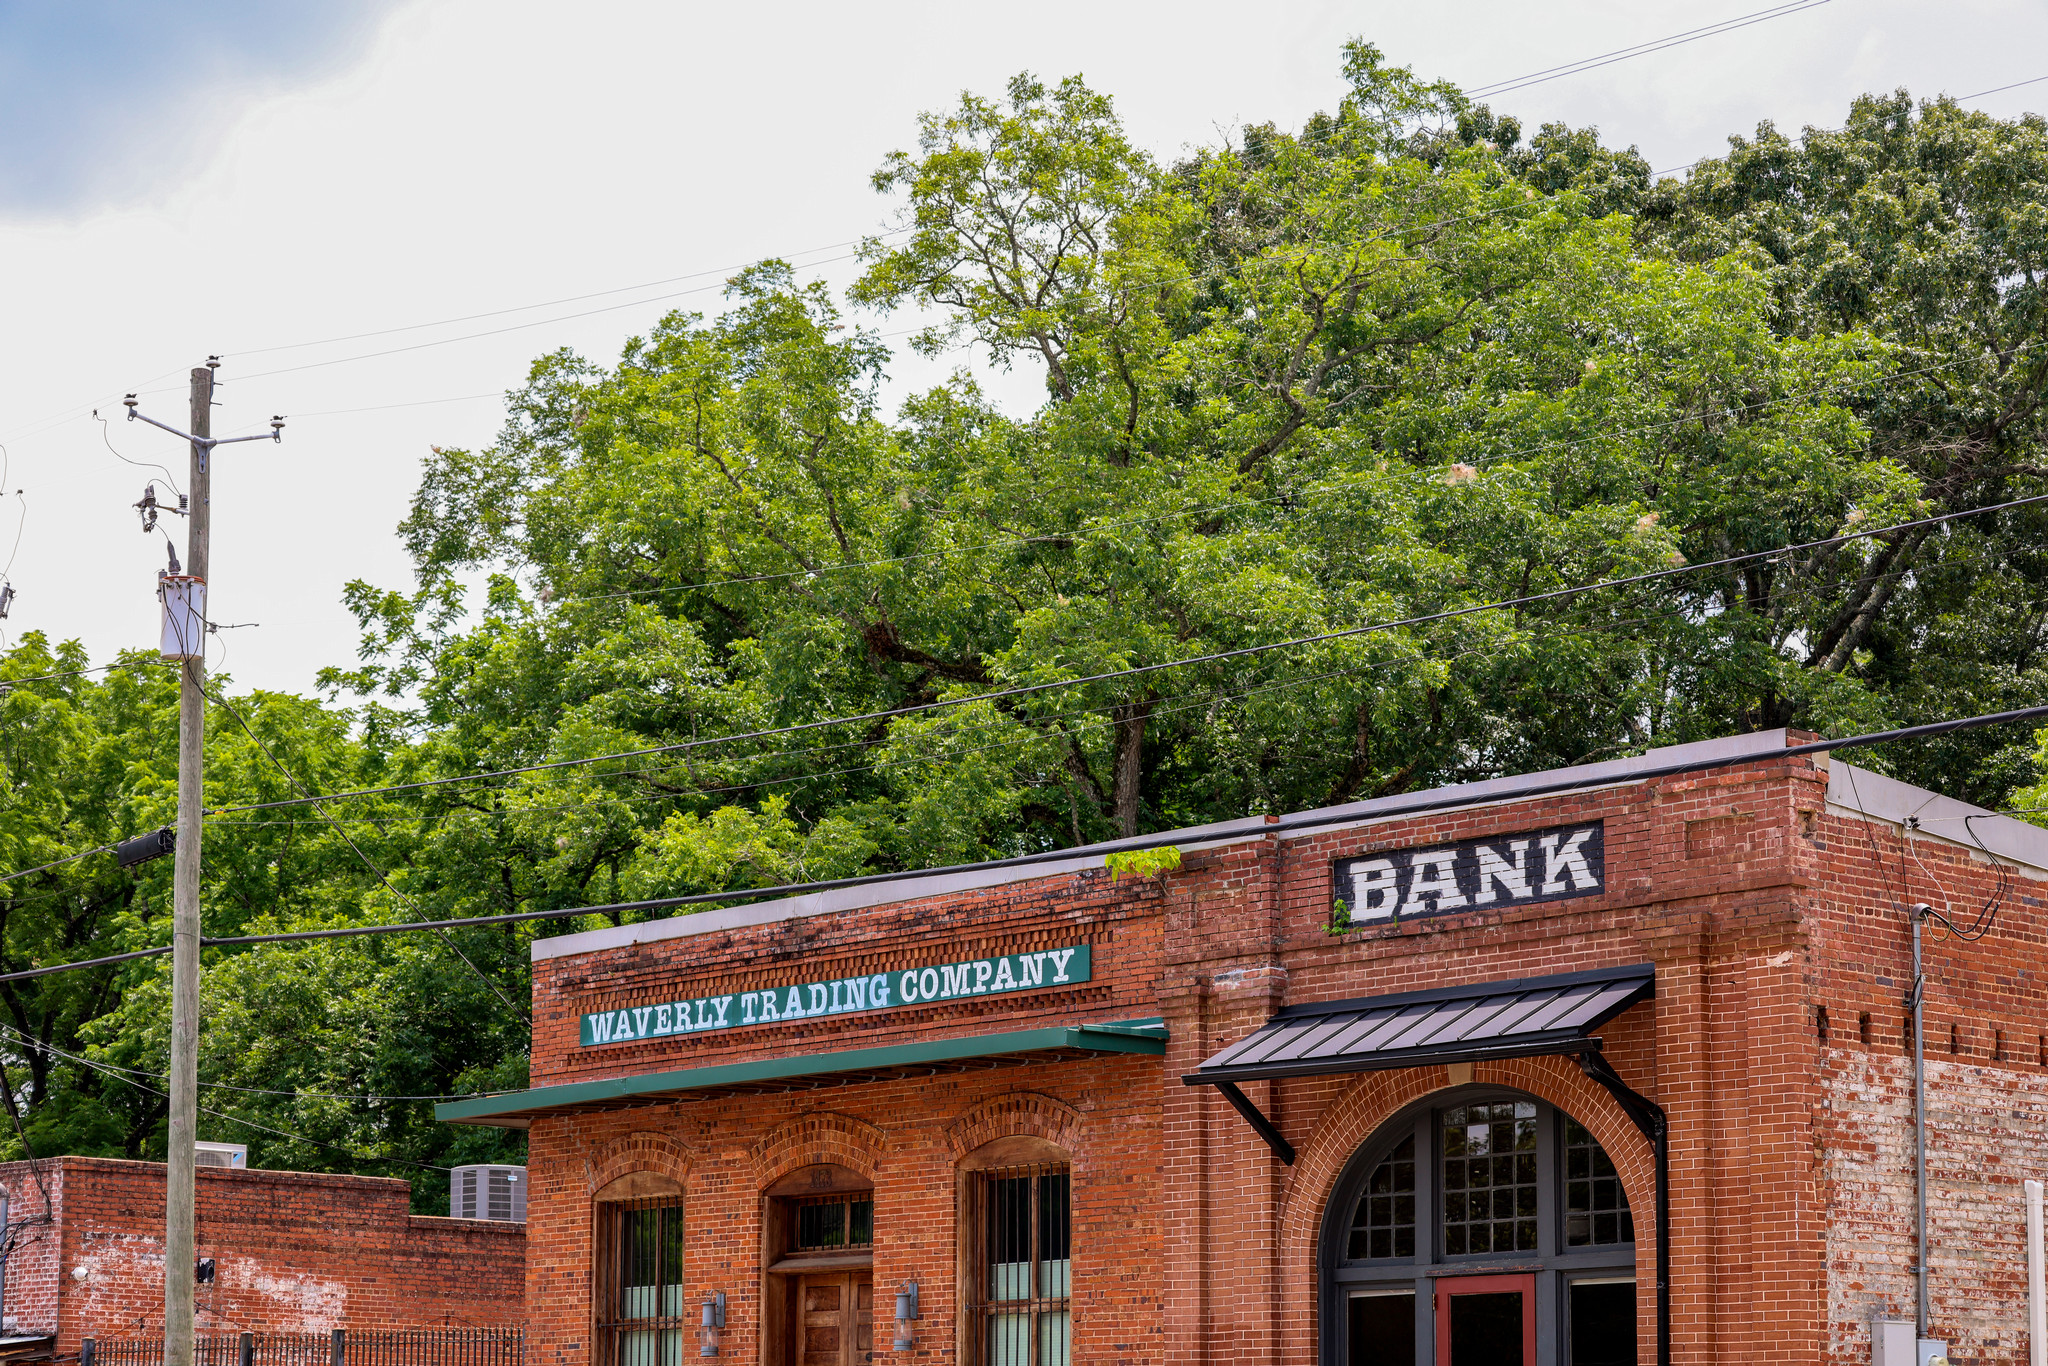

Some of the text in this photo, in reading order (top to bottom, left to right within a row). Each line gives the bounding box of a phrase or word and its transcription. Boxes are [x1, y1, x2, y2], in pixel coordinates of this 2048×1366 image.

[1350, 830, 1599, 922] BANK
[588, 948, 1075, 1043] WAVERLY TRADING COMPANY
